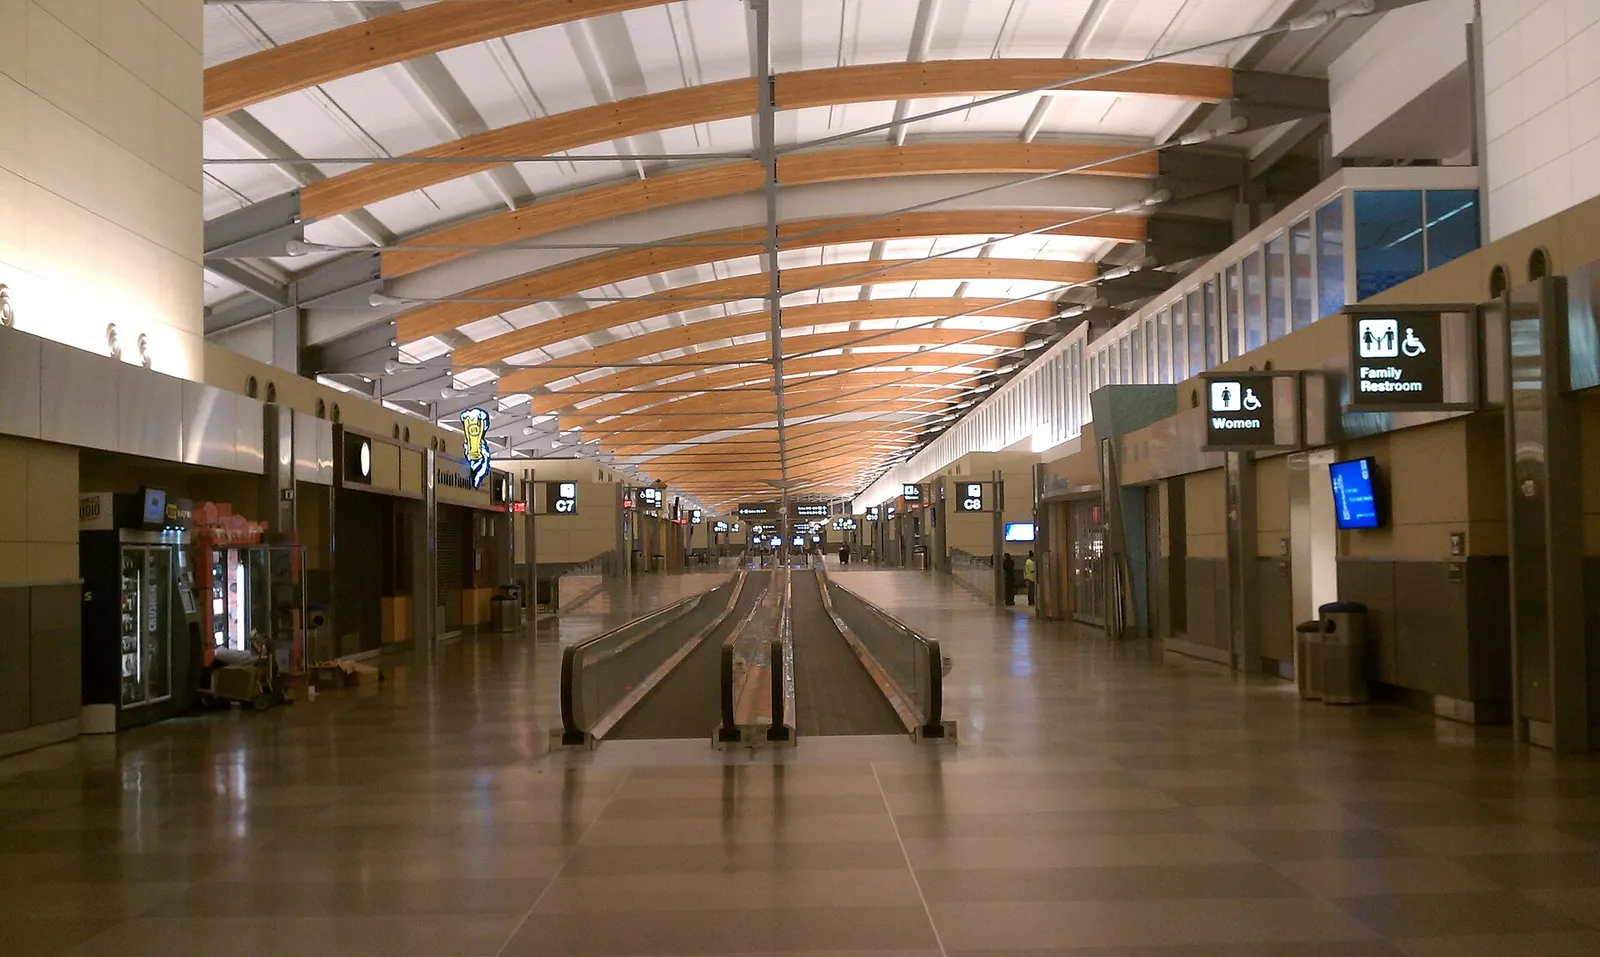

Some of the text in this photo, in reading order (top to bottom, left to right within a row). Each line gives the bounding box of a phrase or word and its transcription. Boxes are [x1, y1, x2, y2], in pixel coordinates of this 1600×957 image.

[1360, 367, 1402, 380] Family
[1360, 380, 1422, 392] Restroom
[1212, 417, 1260, 429] Women
[555, 499, 575, 512] C7
[963, 498, 982, 510] C8
